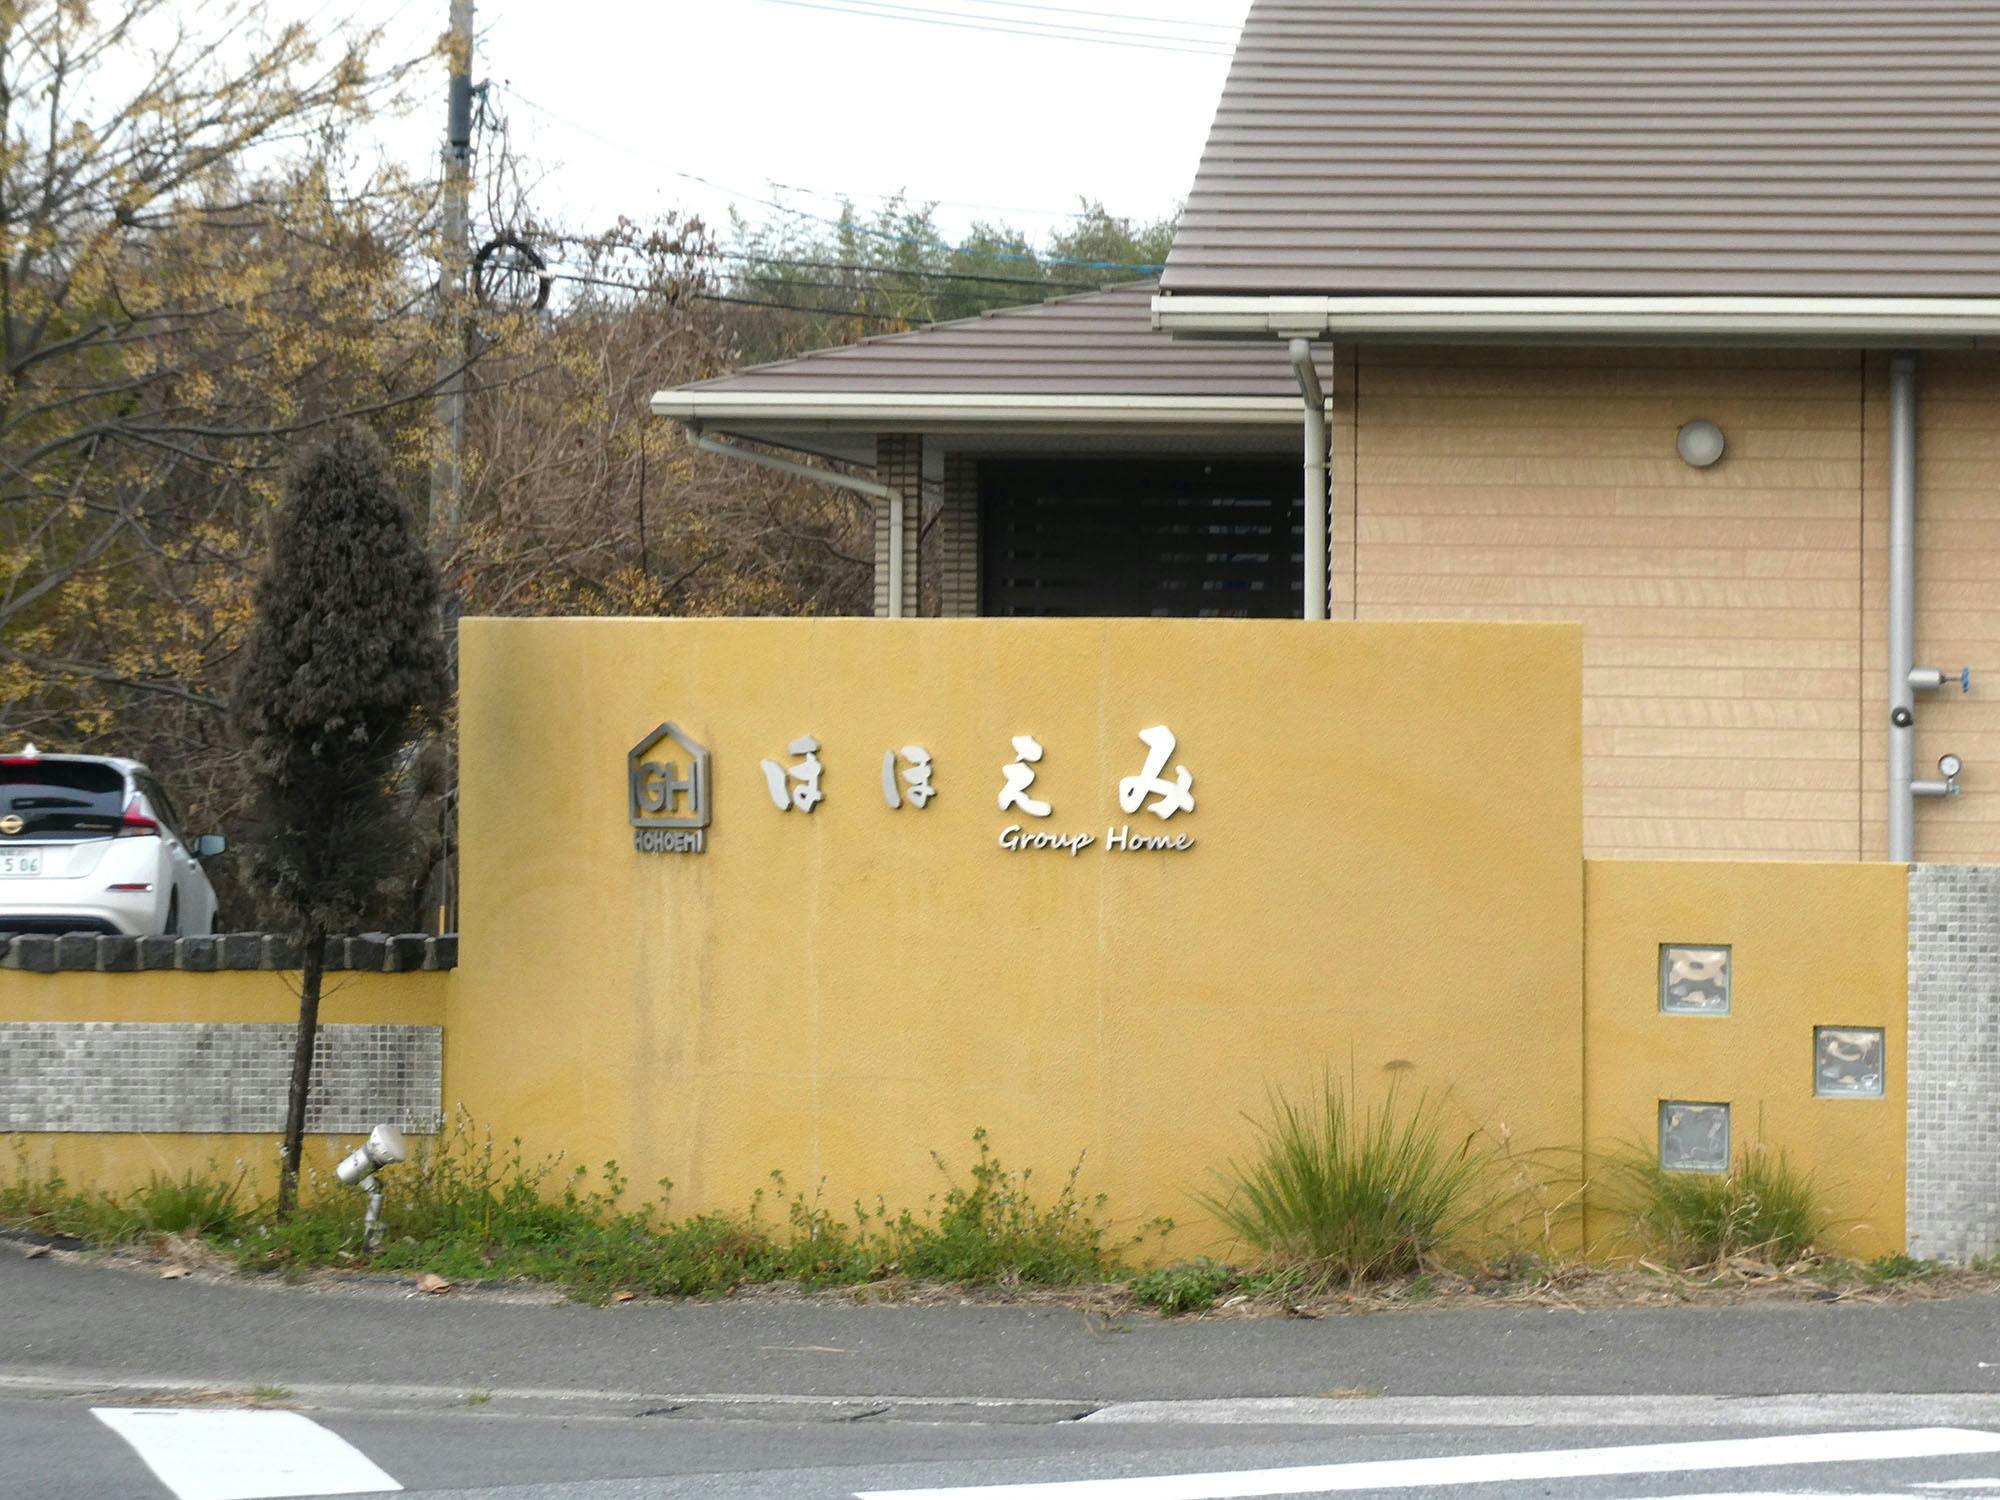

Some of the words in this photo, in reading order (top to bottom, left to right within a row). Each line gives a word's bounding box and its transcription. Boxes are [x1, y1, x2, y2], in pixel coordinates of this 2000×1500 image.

[636, 762, 698, 812] GH
[761, 725, 1195, 819] ほほえみ
[634, 829, 703, 853] HOHOEMI
[998, 824, 1095, 857] Group
[1105, 825, 1195, 851] Home
